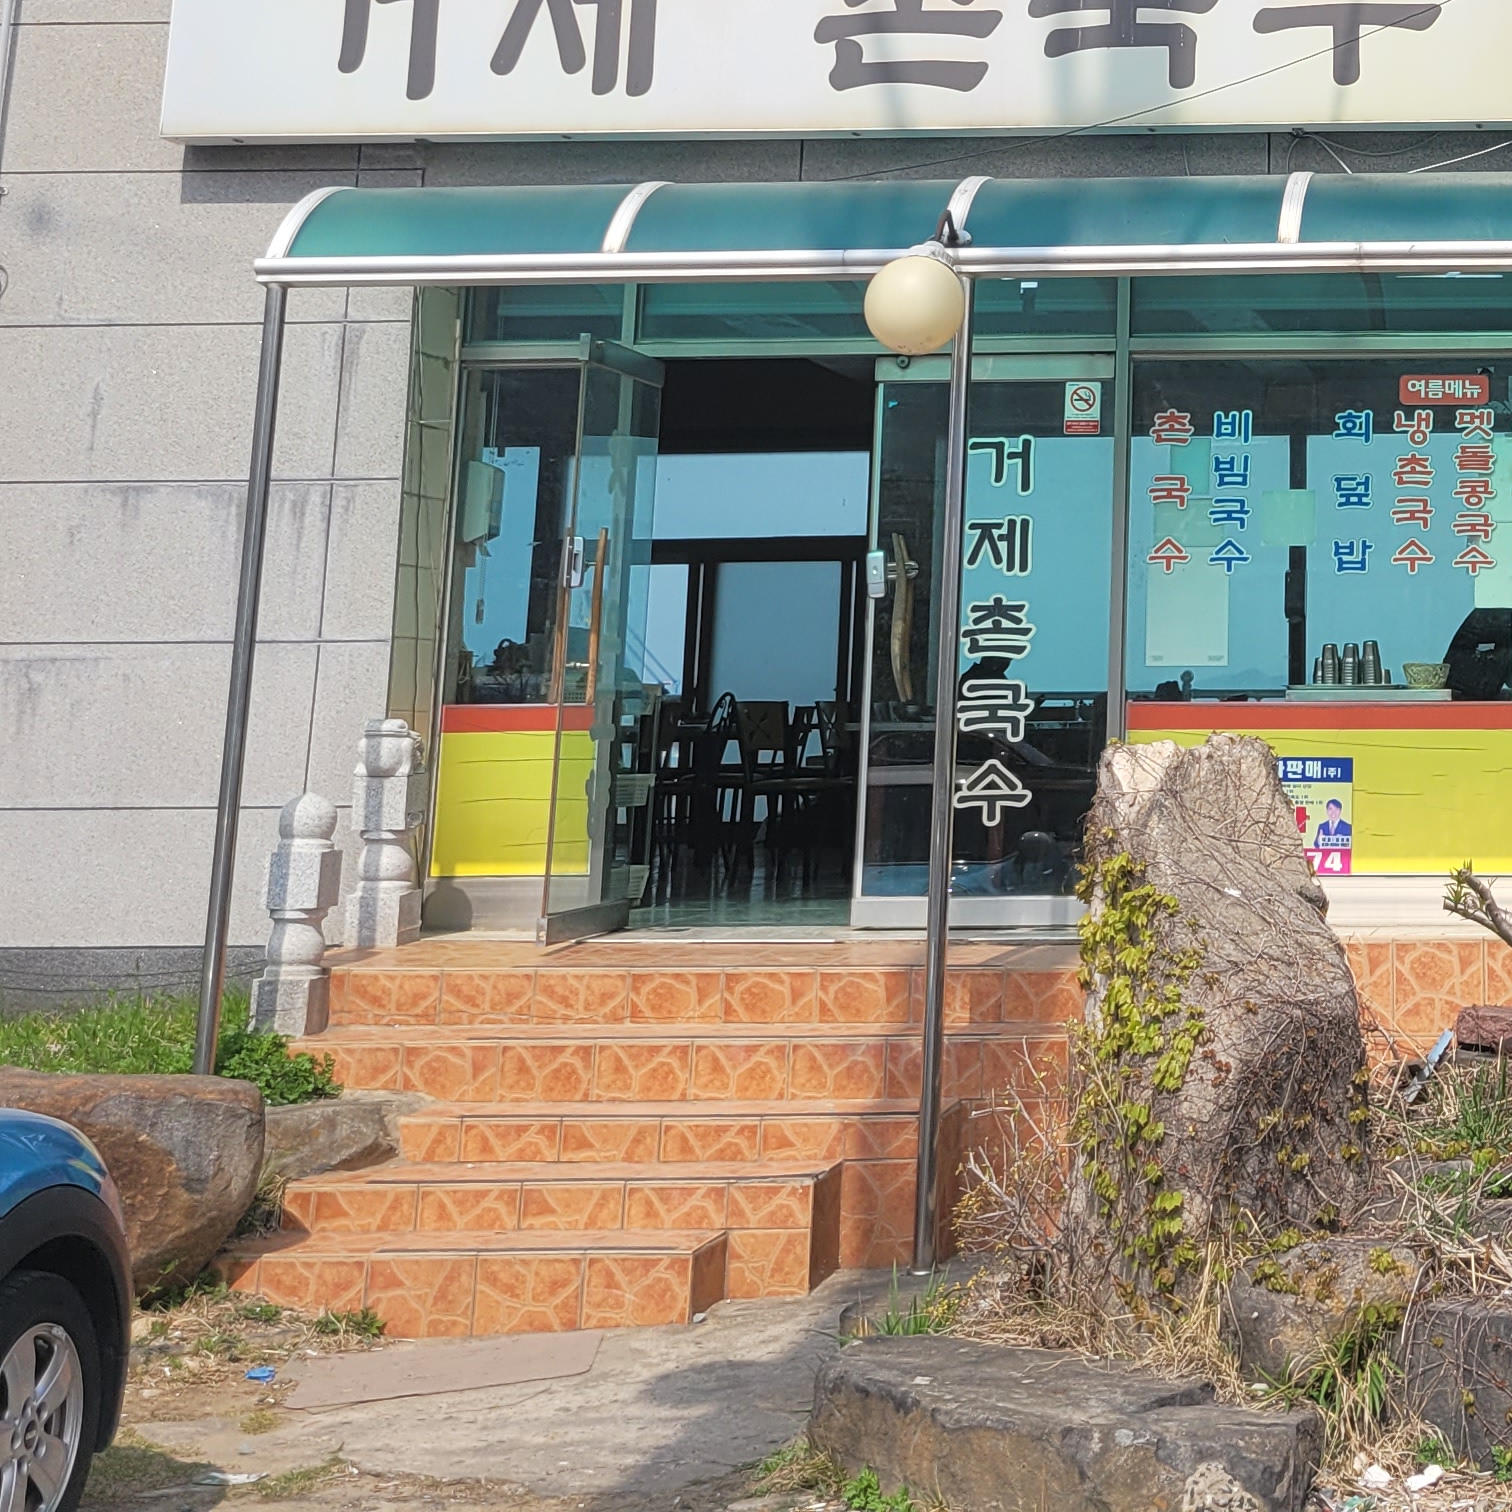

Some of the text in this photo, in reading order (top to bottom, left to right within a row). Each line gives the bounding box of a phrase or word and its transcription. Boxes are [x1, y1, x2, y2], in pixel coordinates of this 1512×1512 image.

[1407, 379, 1482, 399] 여름메뉴
[1147, 409, 1194, 573] 촌국수
[1208, 410, 1252, 574] 비빔국수
[1332, 409, 1374, 575] 회덮밥
[1390, 410, 1435, 574] 냉촌국수
[953, 434, 1036, 828] 거제촌국수
